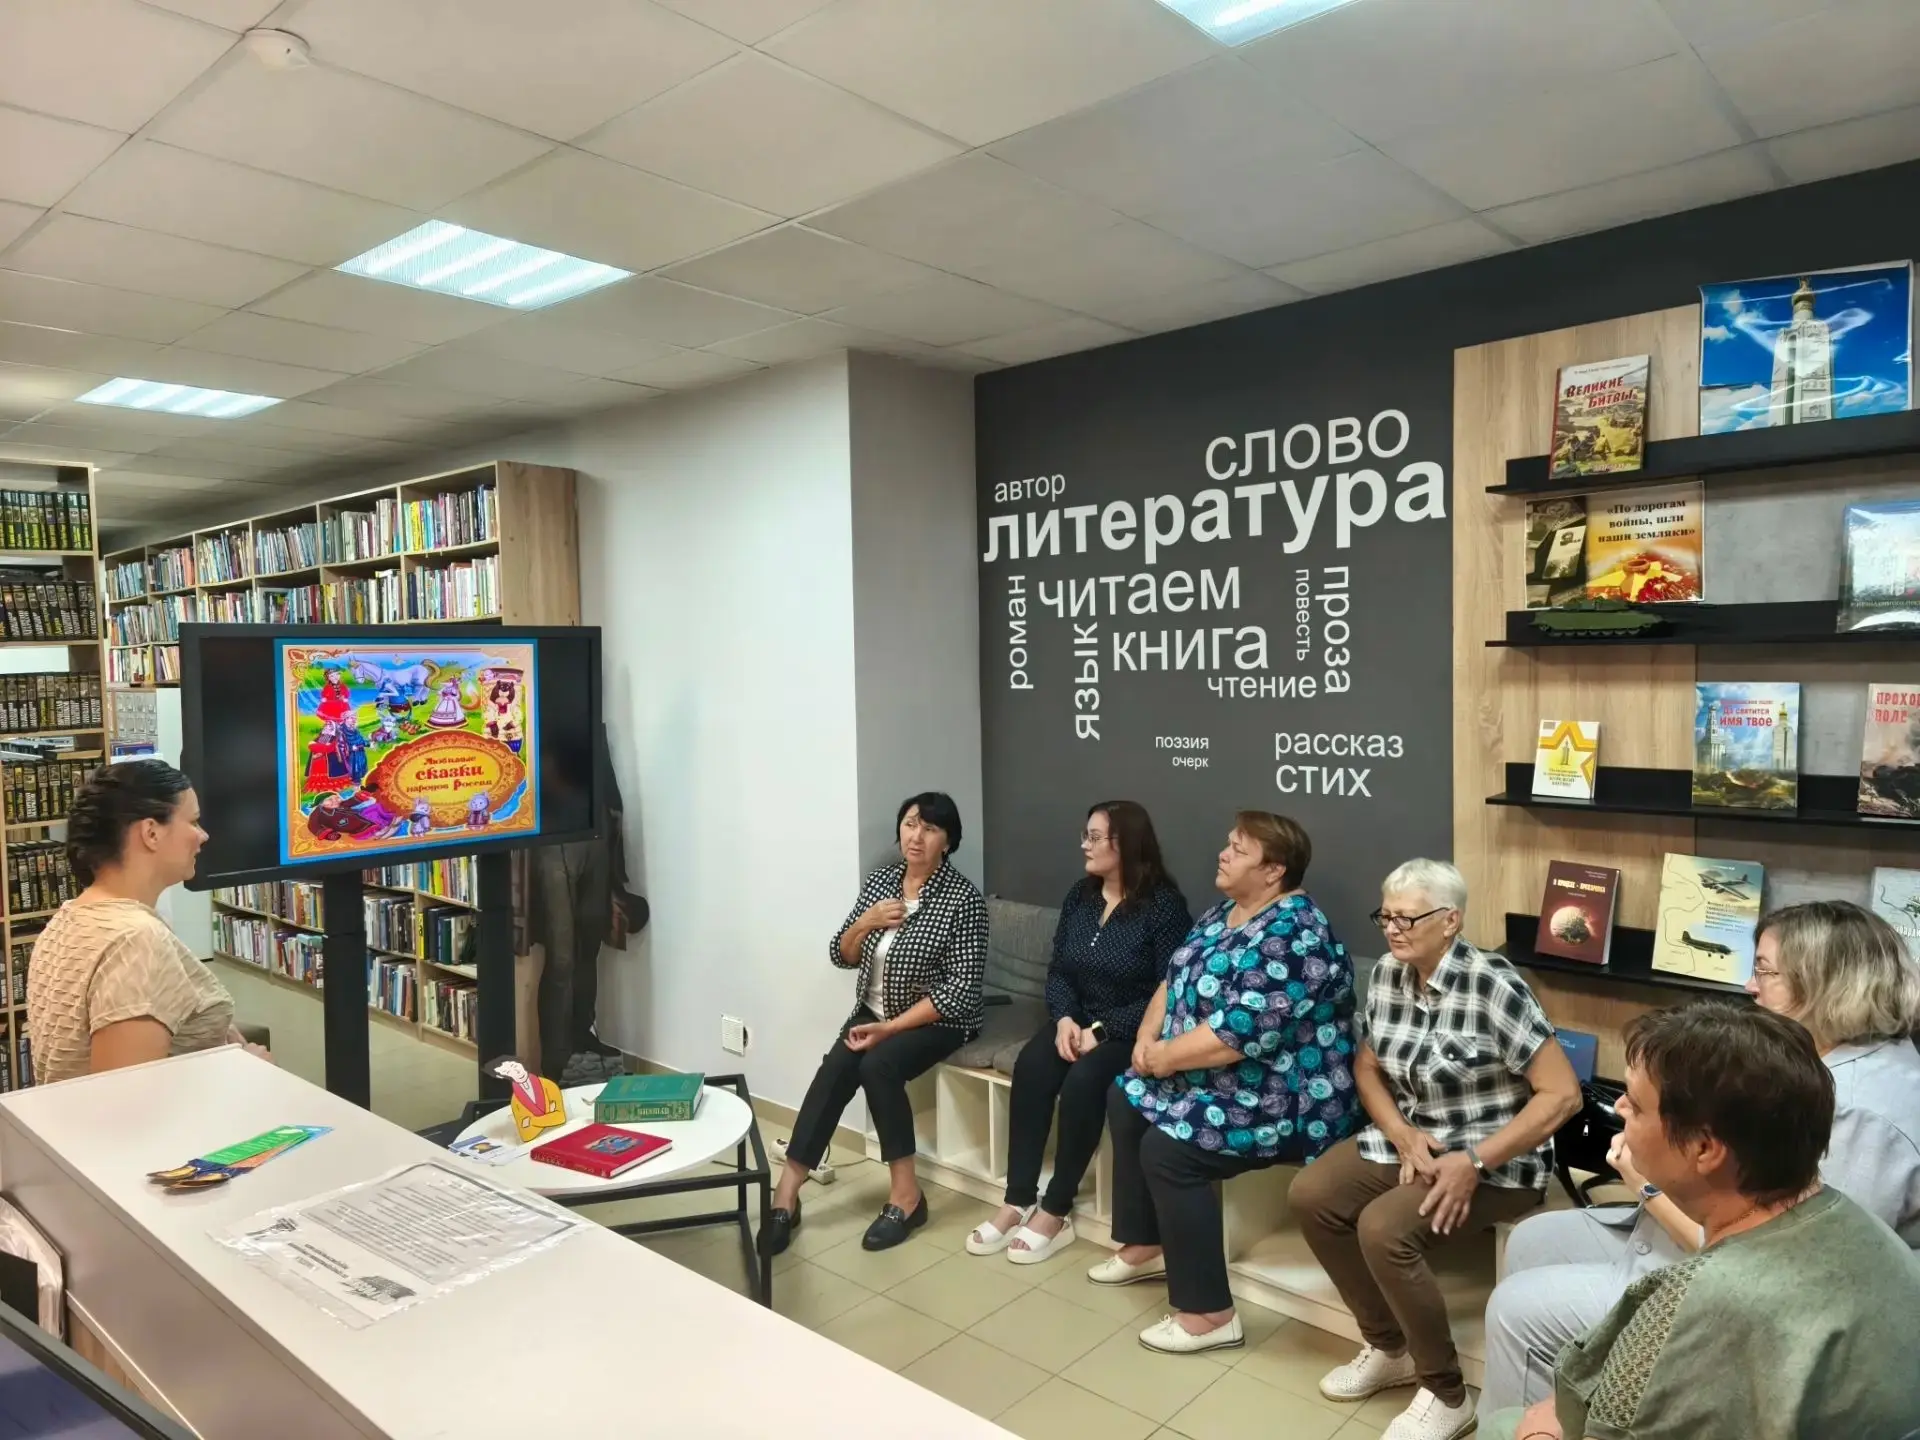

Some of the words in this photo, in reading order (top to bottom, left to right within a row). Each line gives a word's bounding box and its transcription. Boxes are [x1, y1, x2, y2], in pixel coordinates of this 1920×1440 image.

[1566, 376, 1624, 398] ВЕЛИКИЕ
[1588, 389, 1633, 409] БИТВЫ
[994, 474, 1066, 503] автор
[983, 461, 1447, 565] литература
[1633, 500, 1686, 514] дорогам
[1609, 516, 1653, 529] войны,
[1656, 514, 1684, 525] шли
[1598, 532, 1632, 543] наши
[1634, 528, 1696, 541] земляки»
[1038, 566, 1241, 618] читаем
[1295, 568, 1311, 662] повесть
[1008, 575, 1034, 690] роман
[1314, 566, 1351, 694] проза
[1112, 624, 1269, 672] книга
[1073, 621, 1101, 741] язык
[1207, 675, 1317, 699] чтение
[1876, 692, 1920, 707] ПРОХО
[1875, 708, 1909, 724] ПОЛЕ
[1155, 735, 1209, 750] поэзия
[1275, 732, 1404, 761] рассказ
[1172, 756, 1209, 771] очерк
[406, 783, 449, 793] народов
[453, 779, 493, 791] России
